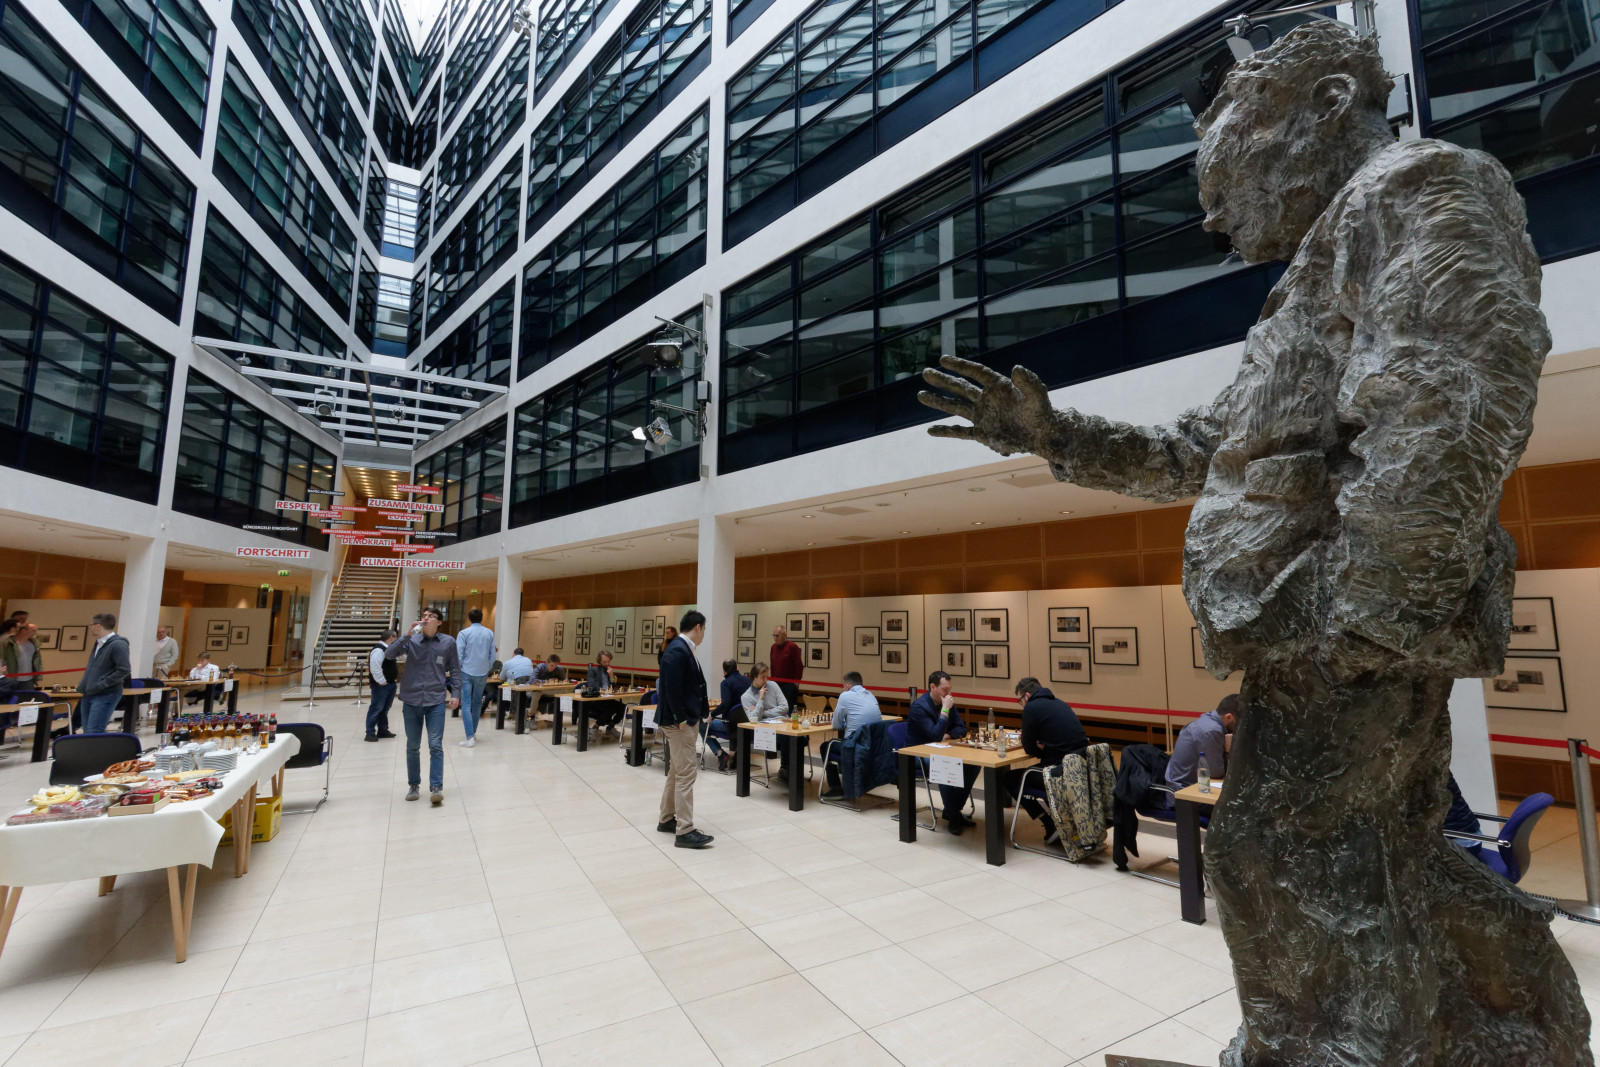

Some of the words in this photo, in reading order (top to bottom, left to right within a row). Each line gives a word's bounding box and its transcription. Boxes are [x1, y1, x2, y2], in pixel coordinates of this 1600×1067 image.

[276, 501, 319, 511] RESPEKT
[369, 499, 443, 512] ZUSAMMENHALT
[238, 548, 308, 557] FORTSCHRITT
[362, 558, 464, 568] KLIMAGERECHTIGKEIT
